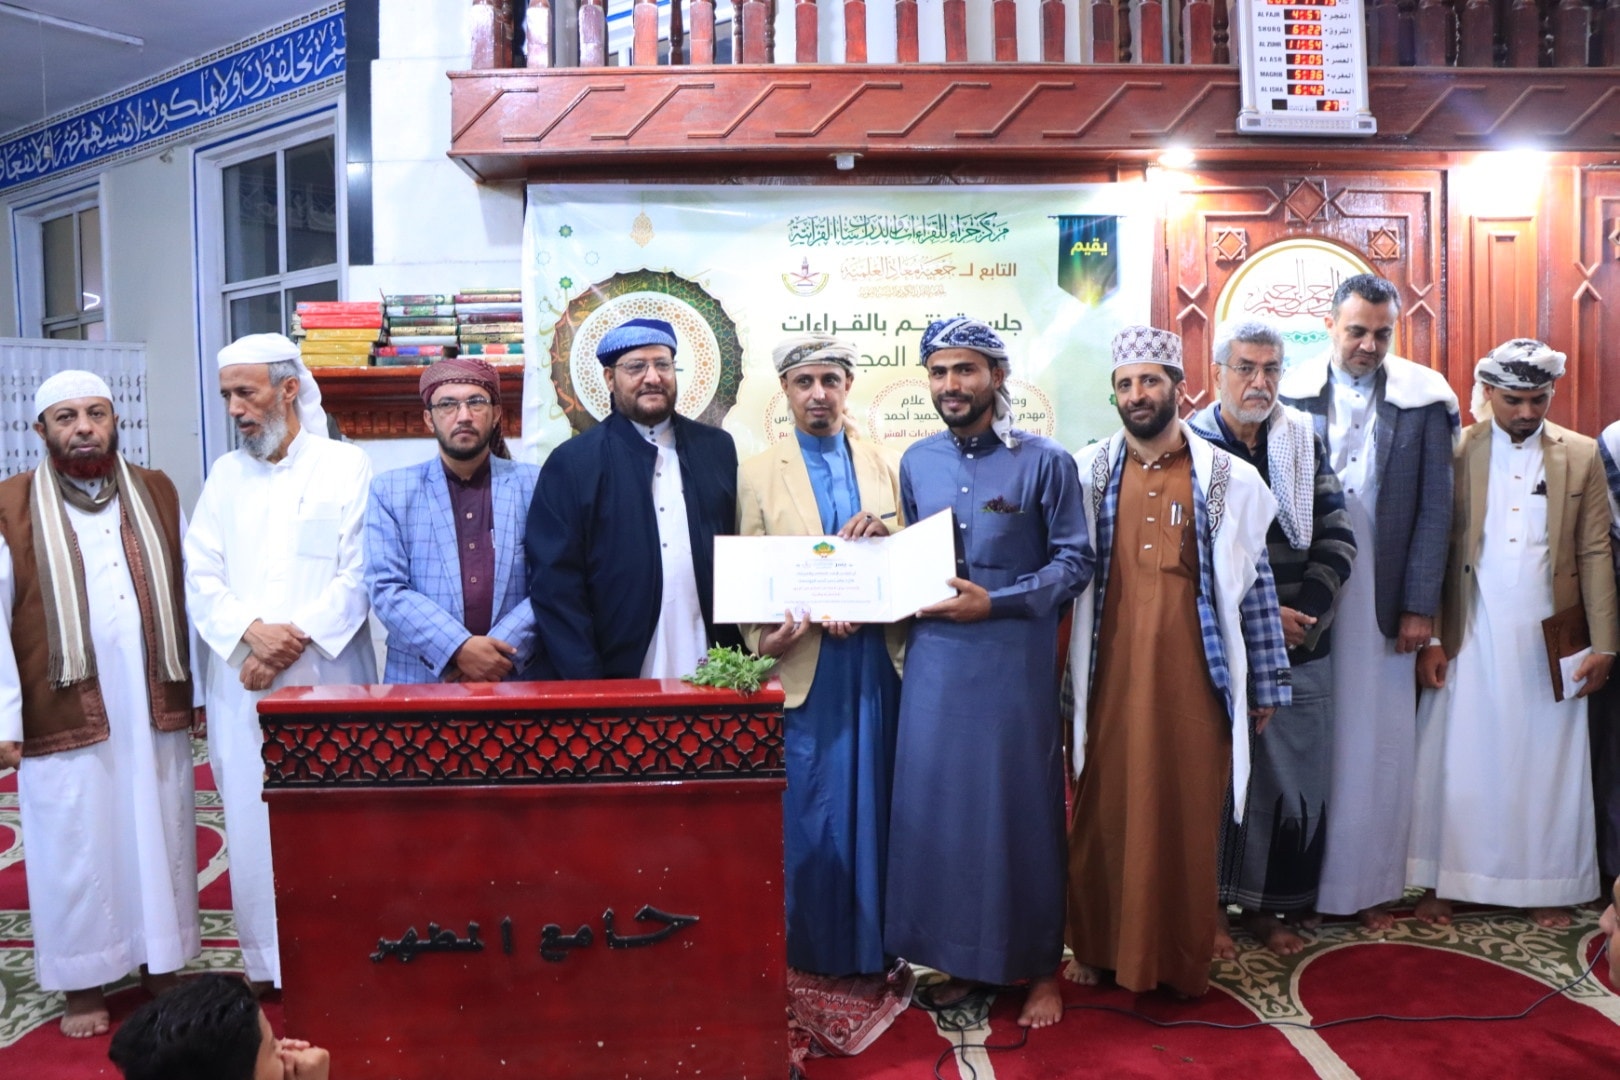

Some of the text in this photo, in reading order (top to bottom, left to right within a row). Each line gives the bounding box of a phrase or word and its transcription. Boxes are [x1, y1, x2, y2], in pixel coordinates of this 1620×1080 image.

[1291, 9, 1321, 20] 4:57
[1292, 24, 1321, 35] 6:22
[1288, 40, 1322, 50] 11:54
[1294, 69, 1323, 80] 5:36
[1294, 84, 1324, 95] 6:42
[1323, 100, 1339, 112] 27
[1069, 236, 1108, 256] يقيم
[979, 262, 1017, 280] التابع
[856, 345, 906, 373] المج
